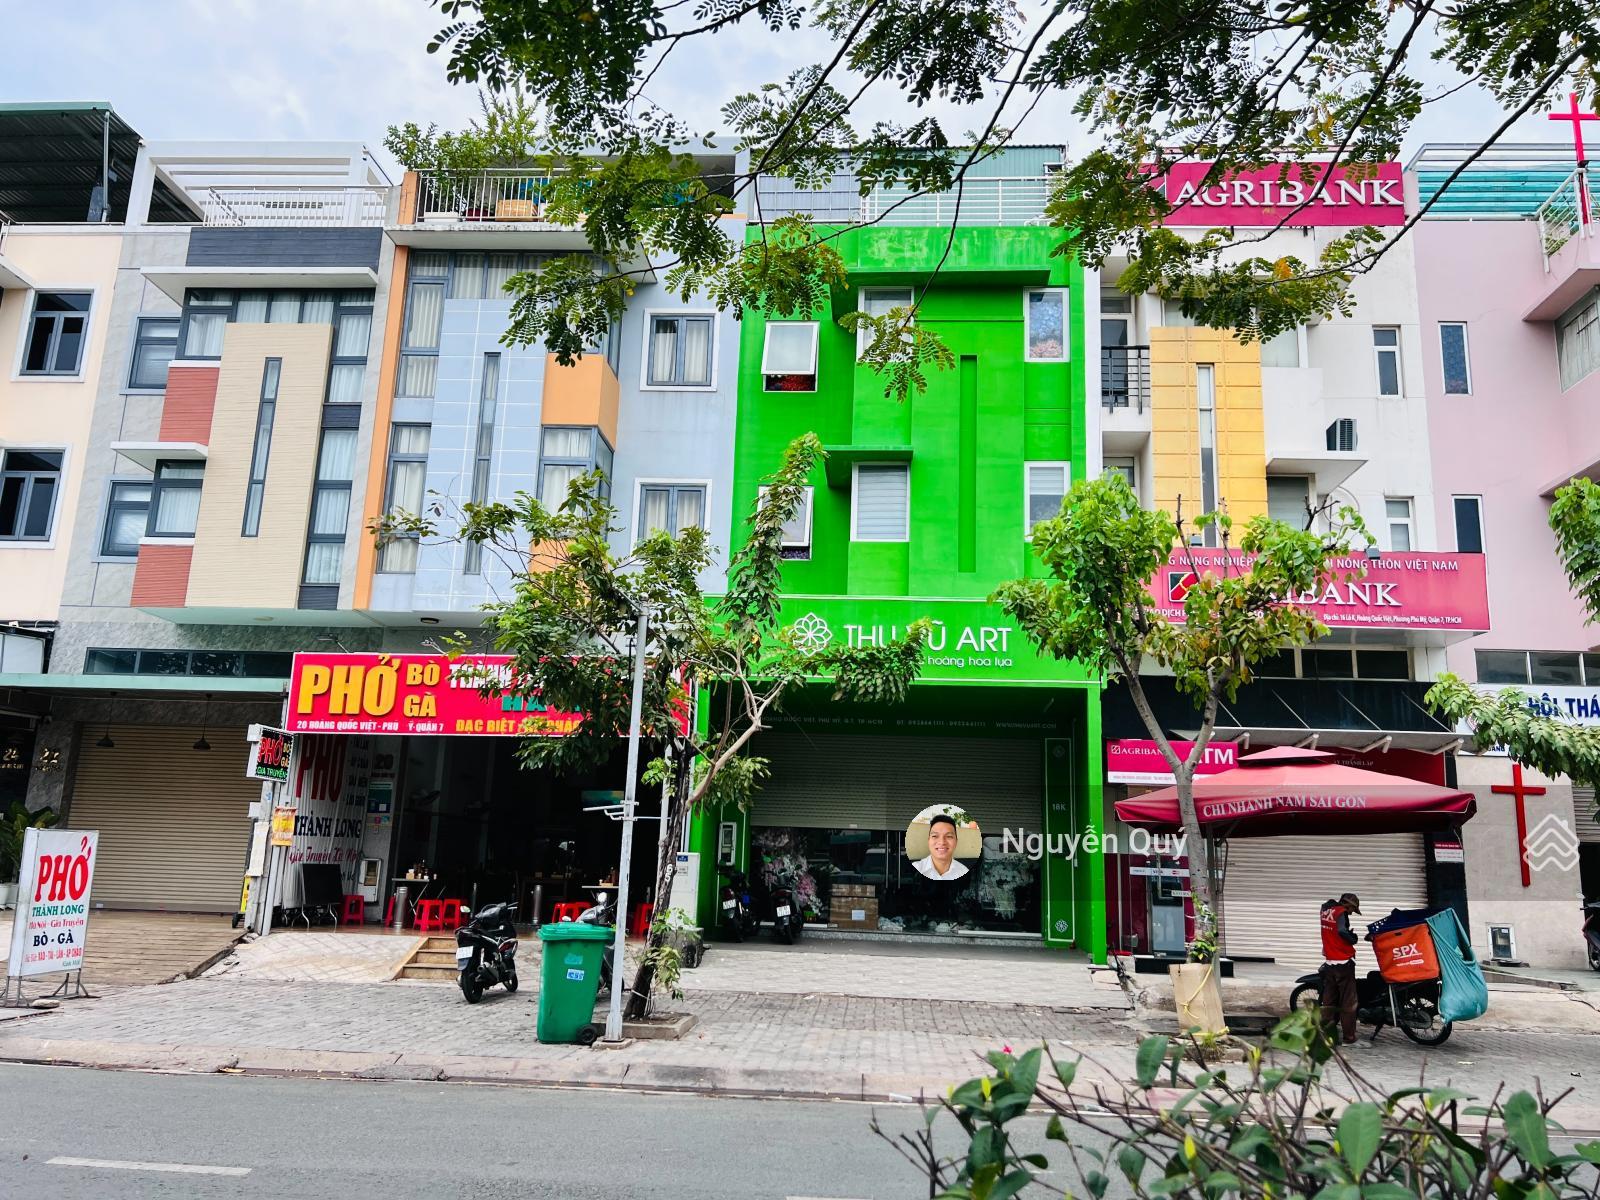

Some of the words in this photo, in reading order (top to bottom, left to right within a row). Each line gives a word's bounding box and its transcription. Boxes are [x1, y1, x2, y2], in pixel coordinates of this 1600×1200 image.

[1172, 180, 1404, 207] AGRIBANK
[1371, 558, 1401, 570] THÔN
[1405, 559, 1428, 572] VIỆT
[1432, 560, 1458, 572] NAM
[956, 627, 1012, 652] ART
[968, 656, 991, 666] hoa
[297, 653, 403, 716] PHỞ
[406, 660, 440, 686] BÒ
[403, 692, 437, 717] GÀ
[297, 720, 307, 729] 20
[309, 719, 335, 730] HOÀNG
[337, 719, 358, 731] QUỐC
[360, 719, 377, 732] VIỆT
[1203, 804, 1226, 817] CHI
[1276, 794, 1306, 808] NAM
[334, 817, 363, 838] LONG
[34, 836, 92, 902] PHỞ
[32, 904, 58, 917] THÀNH
[60, 904, 84, 915] LONG
[33, 931, 48, 947] BÒ
[57, 929, 74, 945] GÀ
[1392, 943, 1419, 958] SPX
